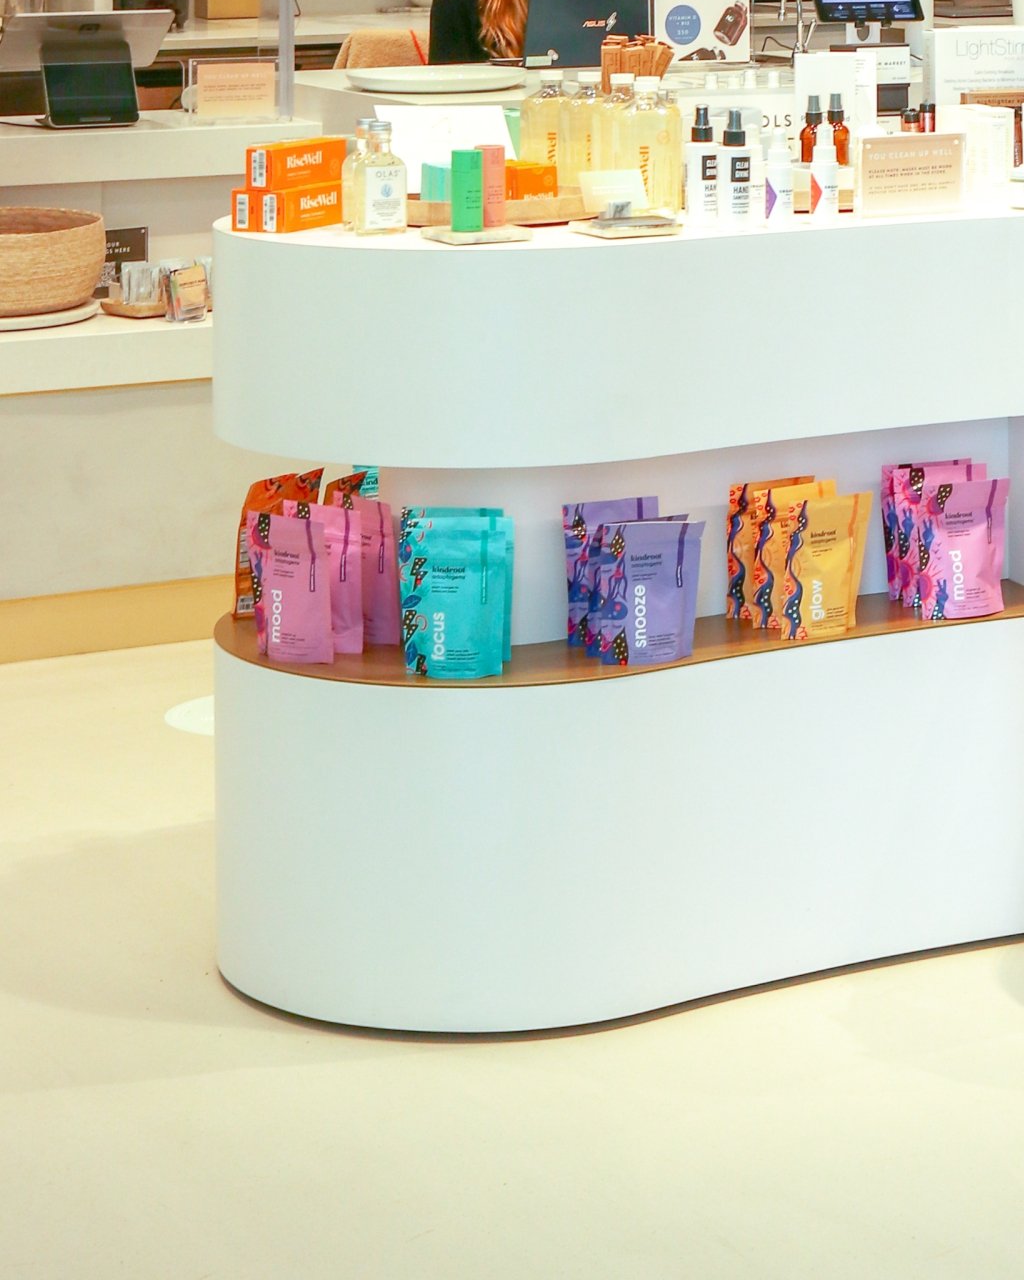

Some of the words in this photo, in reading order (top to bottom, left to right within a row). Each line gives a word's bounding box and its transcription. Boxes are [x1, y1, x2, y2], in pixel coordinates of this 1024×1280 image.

[286, 150, 323, 169] RiseWell
[300, 191, 338, 211] RiseWell
[810, 579, 825, 620] glow
[948, 550, 965, 601] mood
[271, 589, 283, 643] mood
[431, 612, 445, 660] focus
[634, 584, 647, 648] snooze
